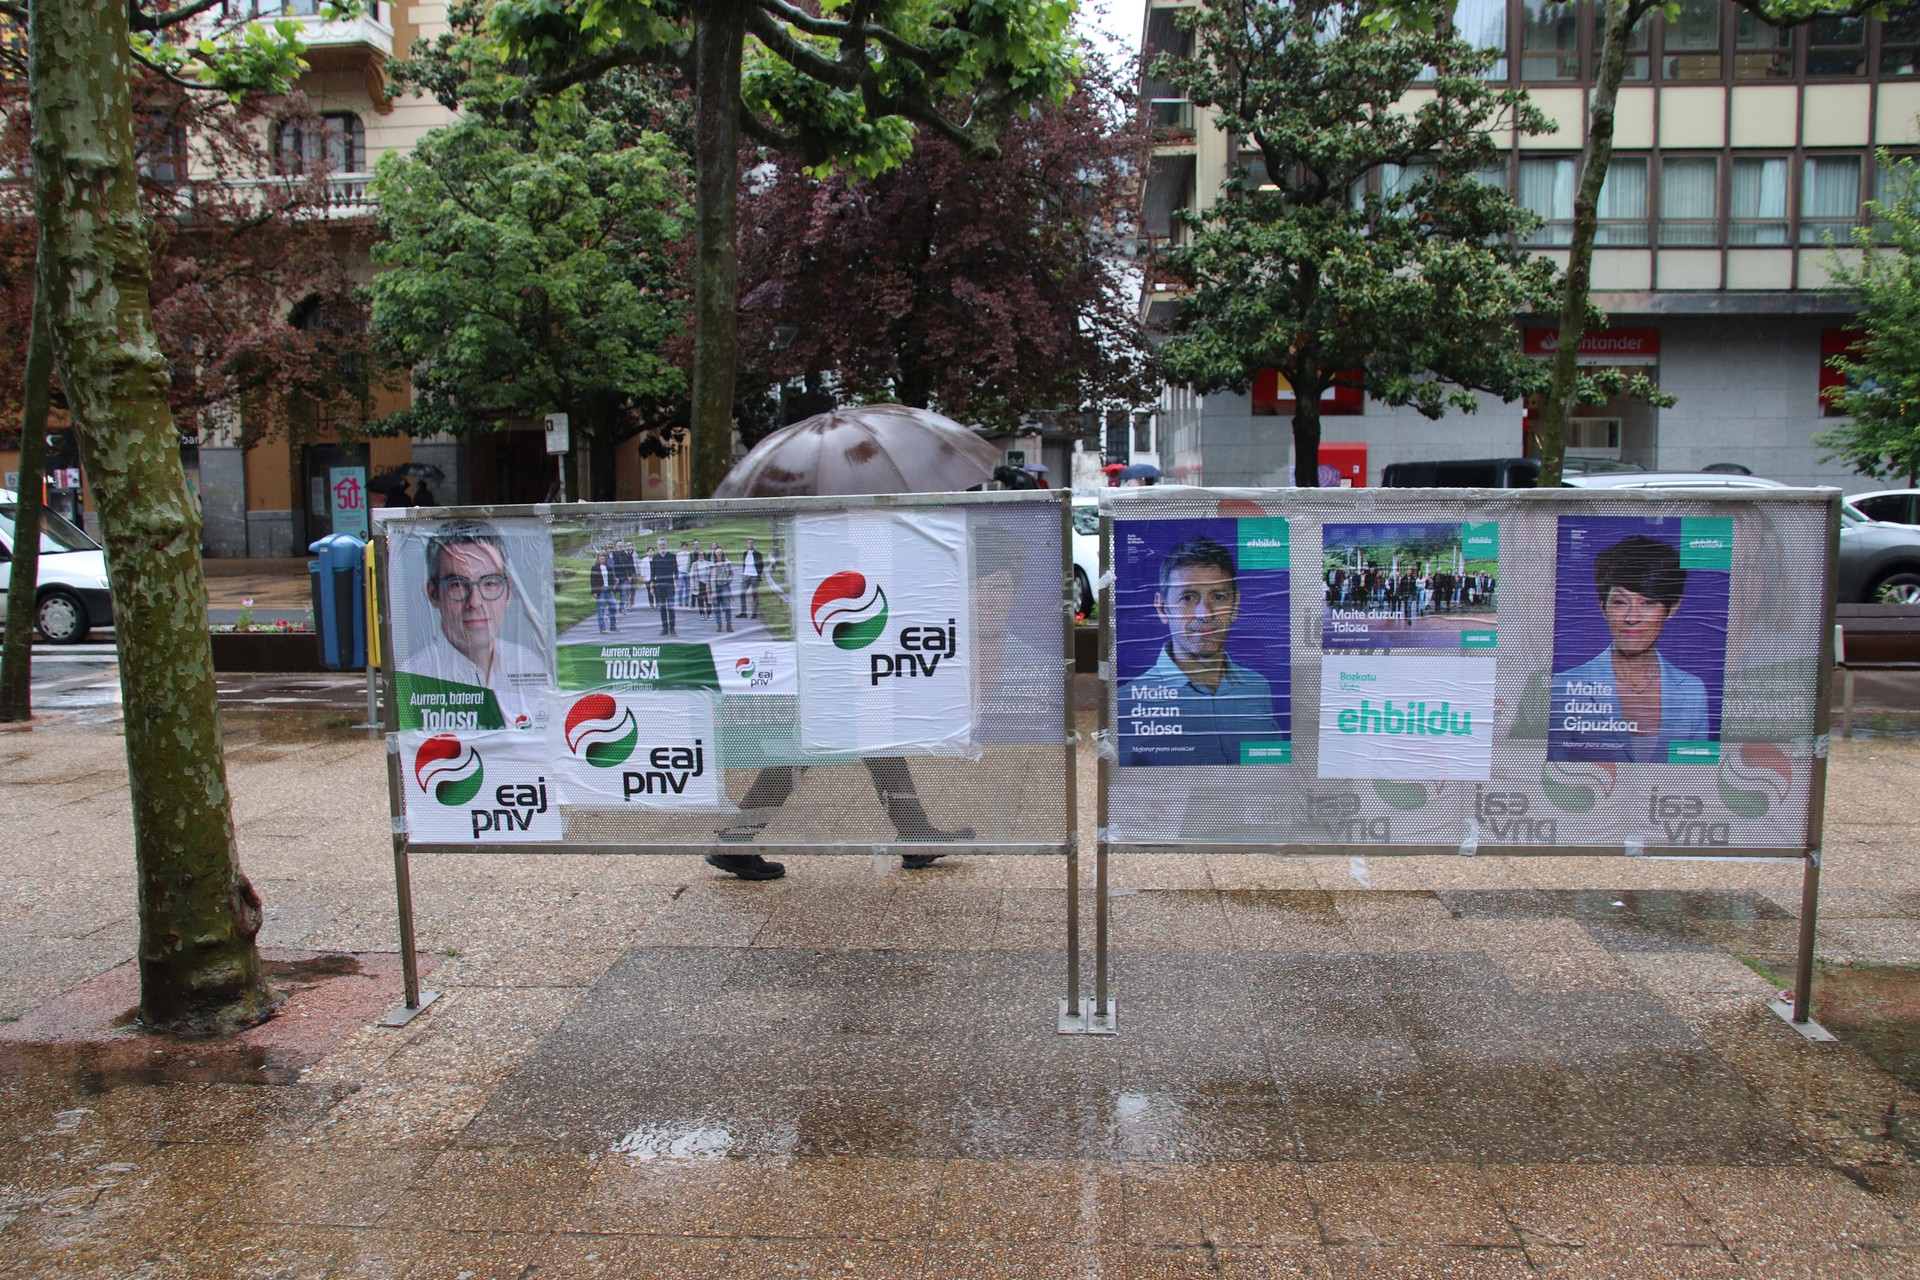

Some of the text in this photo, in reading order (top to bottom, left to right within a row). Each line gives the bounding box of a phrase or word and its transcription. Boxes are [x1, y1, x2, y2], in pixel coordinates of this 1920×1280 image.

[1579, 336, 1643, 350] ntander
[1246, 538, 1280, 548] ehbildu
[1332, 609, 1403, 620] Maite duzun
[1332, 622, 1368, 633] Tolosa
[900, 618, 956, 659] eaj
[601, 646, 660, 659] Aurrera, batera!
[605, 660, 660, 680] TOLOSA
[758, 670, 773, 680] eaj
[871, 653, 942, 686] pnv
[1340, 671, 1377, 681] Bozkatu
[750, 678, 769, 688] pnv
[1566, 681, 1613, 696] Maite
[410, 691, 484, 706] Aurrera, batera!
[1131, 685, 1178, 700] Maite
[1131, 703, 1180, 717] duzun
[1564, 699, 1613, 714] duzun
[421, 708, 478, 731] Tolosa
[1338, 700, 1472, 736] ehbildu
[1563, 716, 1638, 734] Gipuzkoa
[1131, 721, 1183, 736] Tolosa
[650, 739, 704, 777] eaj
[623, 771, 690, 802] pnv
[496, 777, 547, 813] eaj
[472, 808, 535, 839] pnv
